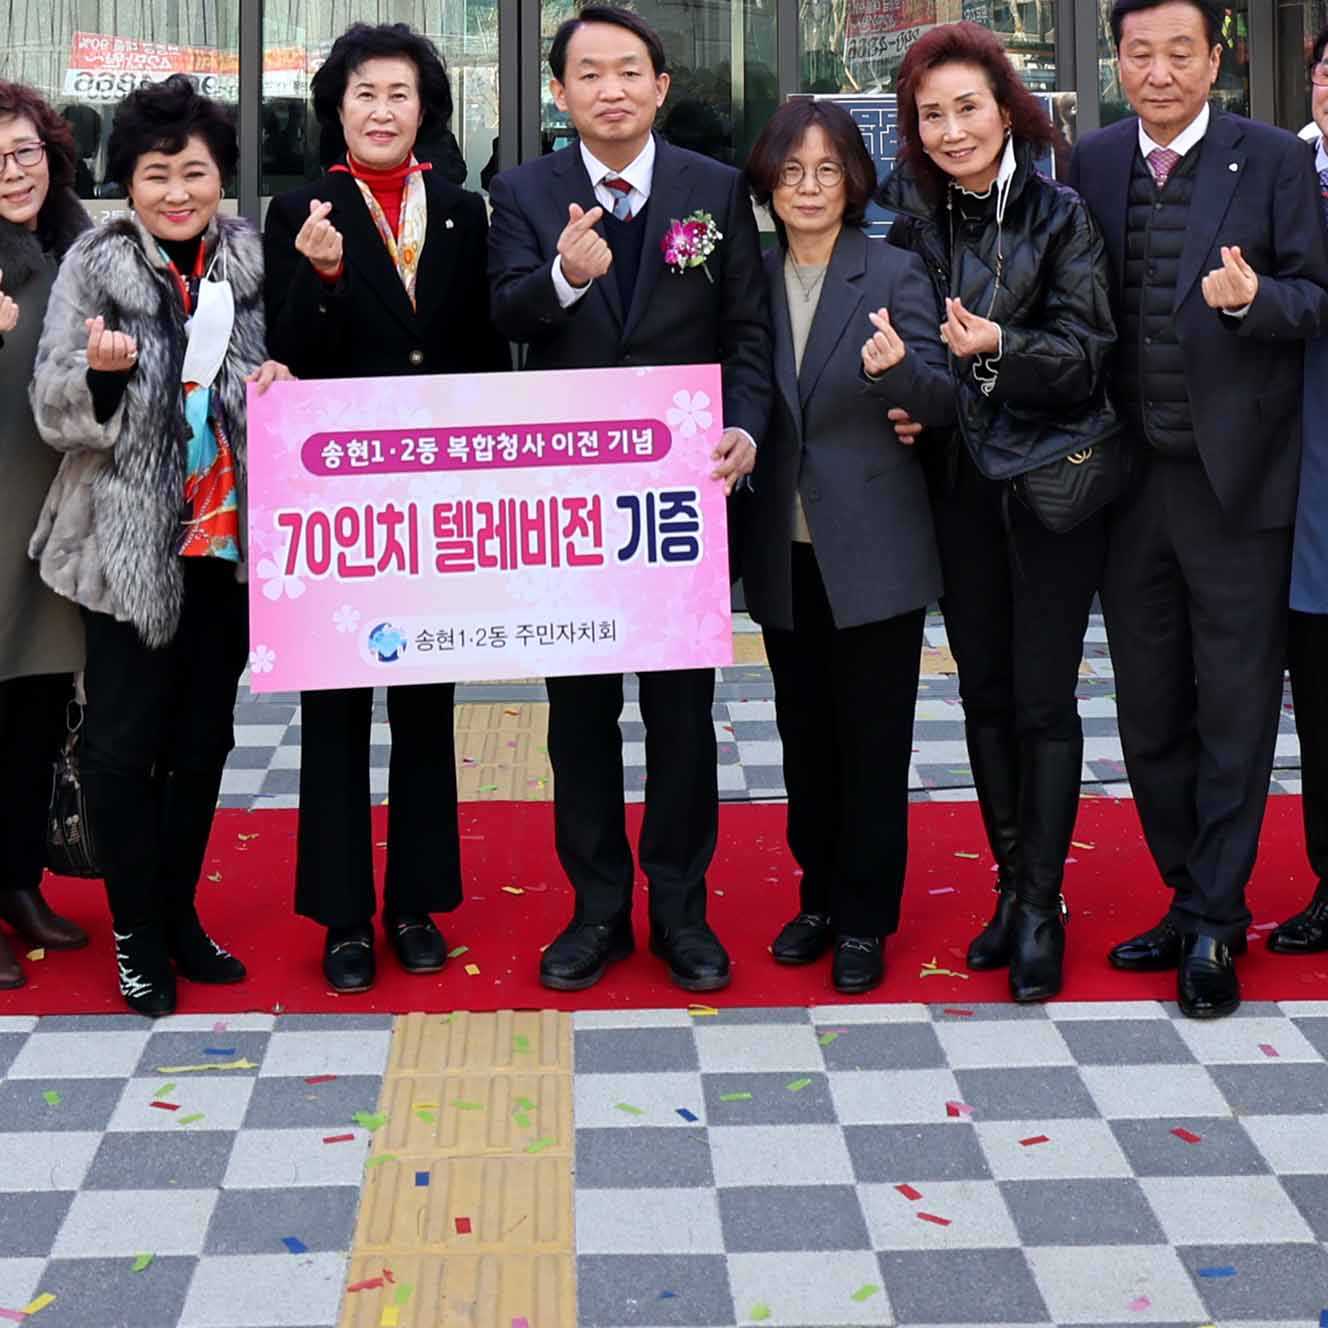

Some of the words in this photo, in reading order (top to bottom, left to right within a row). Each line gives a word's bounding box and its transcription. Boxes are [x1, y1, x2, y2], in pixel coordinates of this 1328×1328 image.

[320, 438, 437, 470] 송현1·2동
[446, 430, 546, 464] 복합청사
[551, 429, 600, 458] 이전
[607, 427, 654, 456] 기념
[278, 501, 420, 578] 70인치
[432, 494, 605, 574] 텔레비전
[616, 489, 700, 564] 기증
[415, 625, 508, 651] 송현1·2동
[515, 618, 617, 648] 주민자치회
